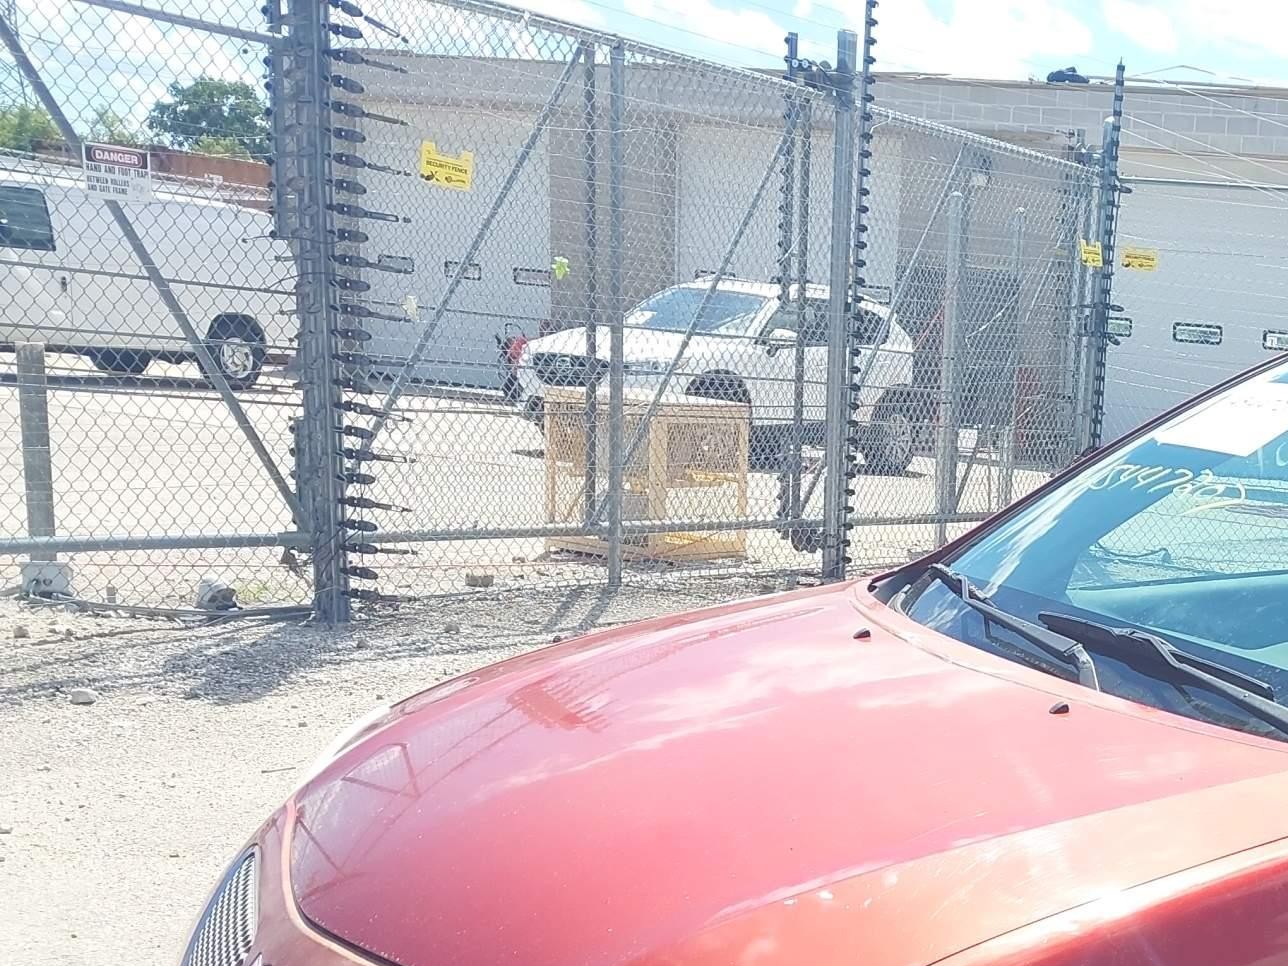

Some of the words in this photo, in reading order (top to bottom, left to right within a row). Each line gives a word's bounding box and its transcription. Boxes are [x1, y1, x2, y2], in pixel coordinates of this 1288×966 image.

[95, 149, 139, 165] DANGER
[86, 162, 102, 173] HAND
[104, 165, 116, 175] AND
[118, 167, 131, 177] FOOT
[133, 169, 149, 178] TRAP
[426, 160, 451, 171] SECURITY
[86, 175, 109, 185] BETWEEN
[110, 178, 130, 187] ROLLERS
[98, 185, 111, 193] GATE
[112, 186, 128, 195] FRAME
